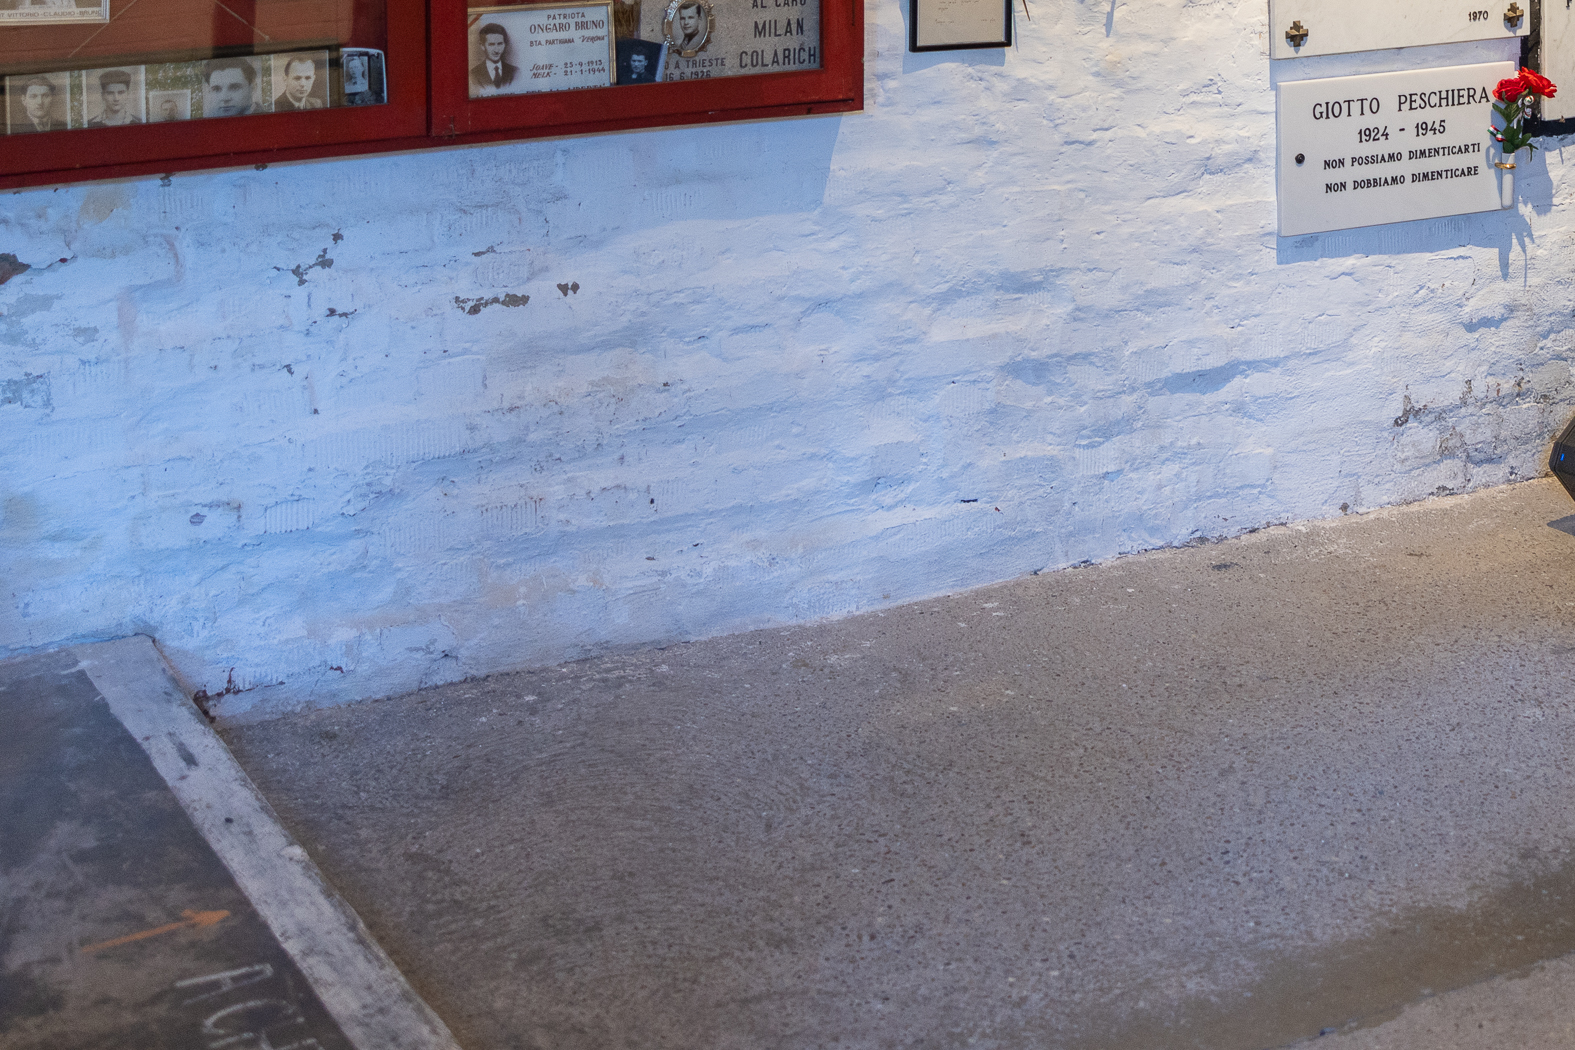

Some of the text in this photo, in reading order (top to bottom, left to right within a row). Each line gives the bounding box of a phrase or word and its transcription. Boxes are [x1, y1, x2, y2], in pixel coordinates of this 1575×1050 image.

[547, 12, 585, 21] PATRIOTA
[1468, 11, 1488, 22] 1970
[530, 20, 604, 34] ONGARO BRUNO
[754, 18, 804, 38] MILAN
[545, 38, 575, 46] PARTIGIANA
[675, 57, 726, 69] A TRIESTE
[740, 46, 816, 68] COLARICH
[1313, 87, 1490, 120] GIOTTO PESCHIERA
[1358, 120, 1446, 143] 1924 1945
[1323, 143, 1480, 170] NON POSSIAMO DIMENTICARTI
[1325, 166, 1479, 193] NON DOBBIAMO DIMENTICARE
